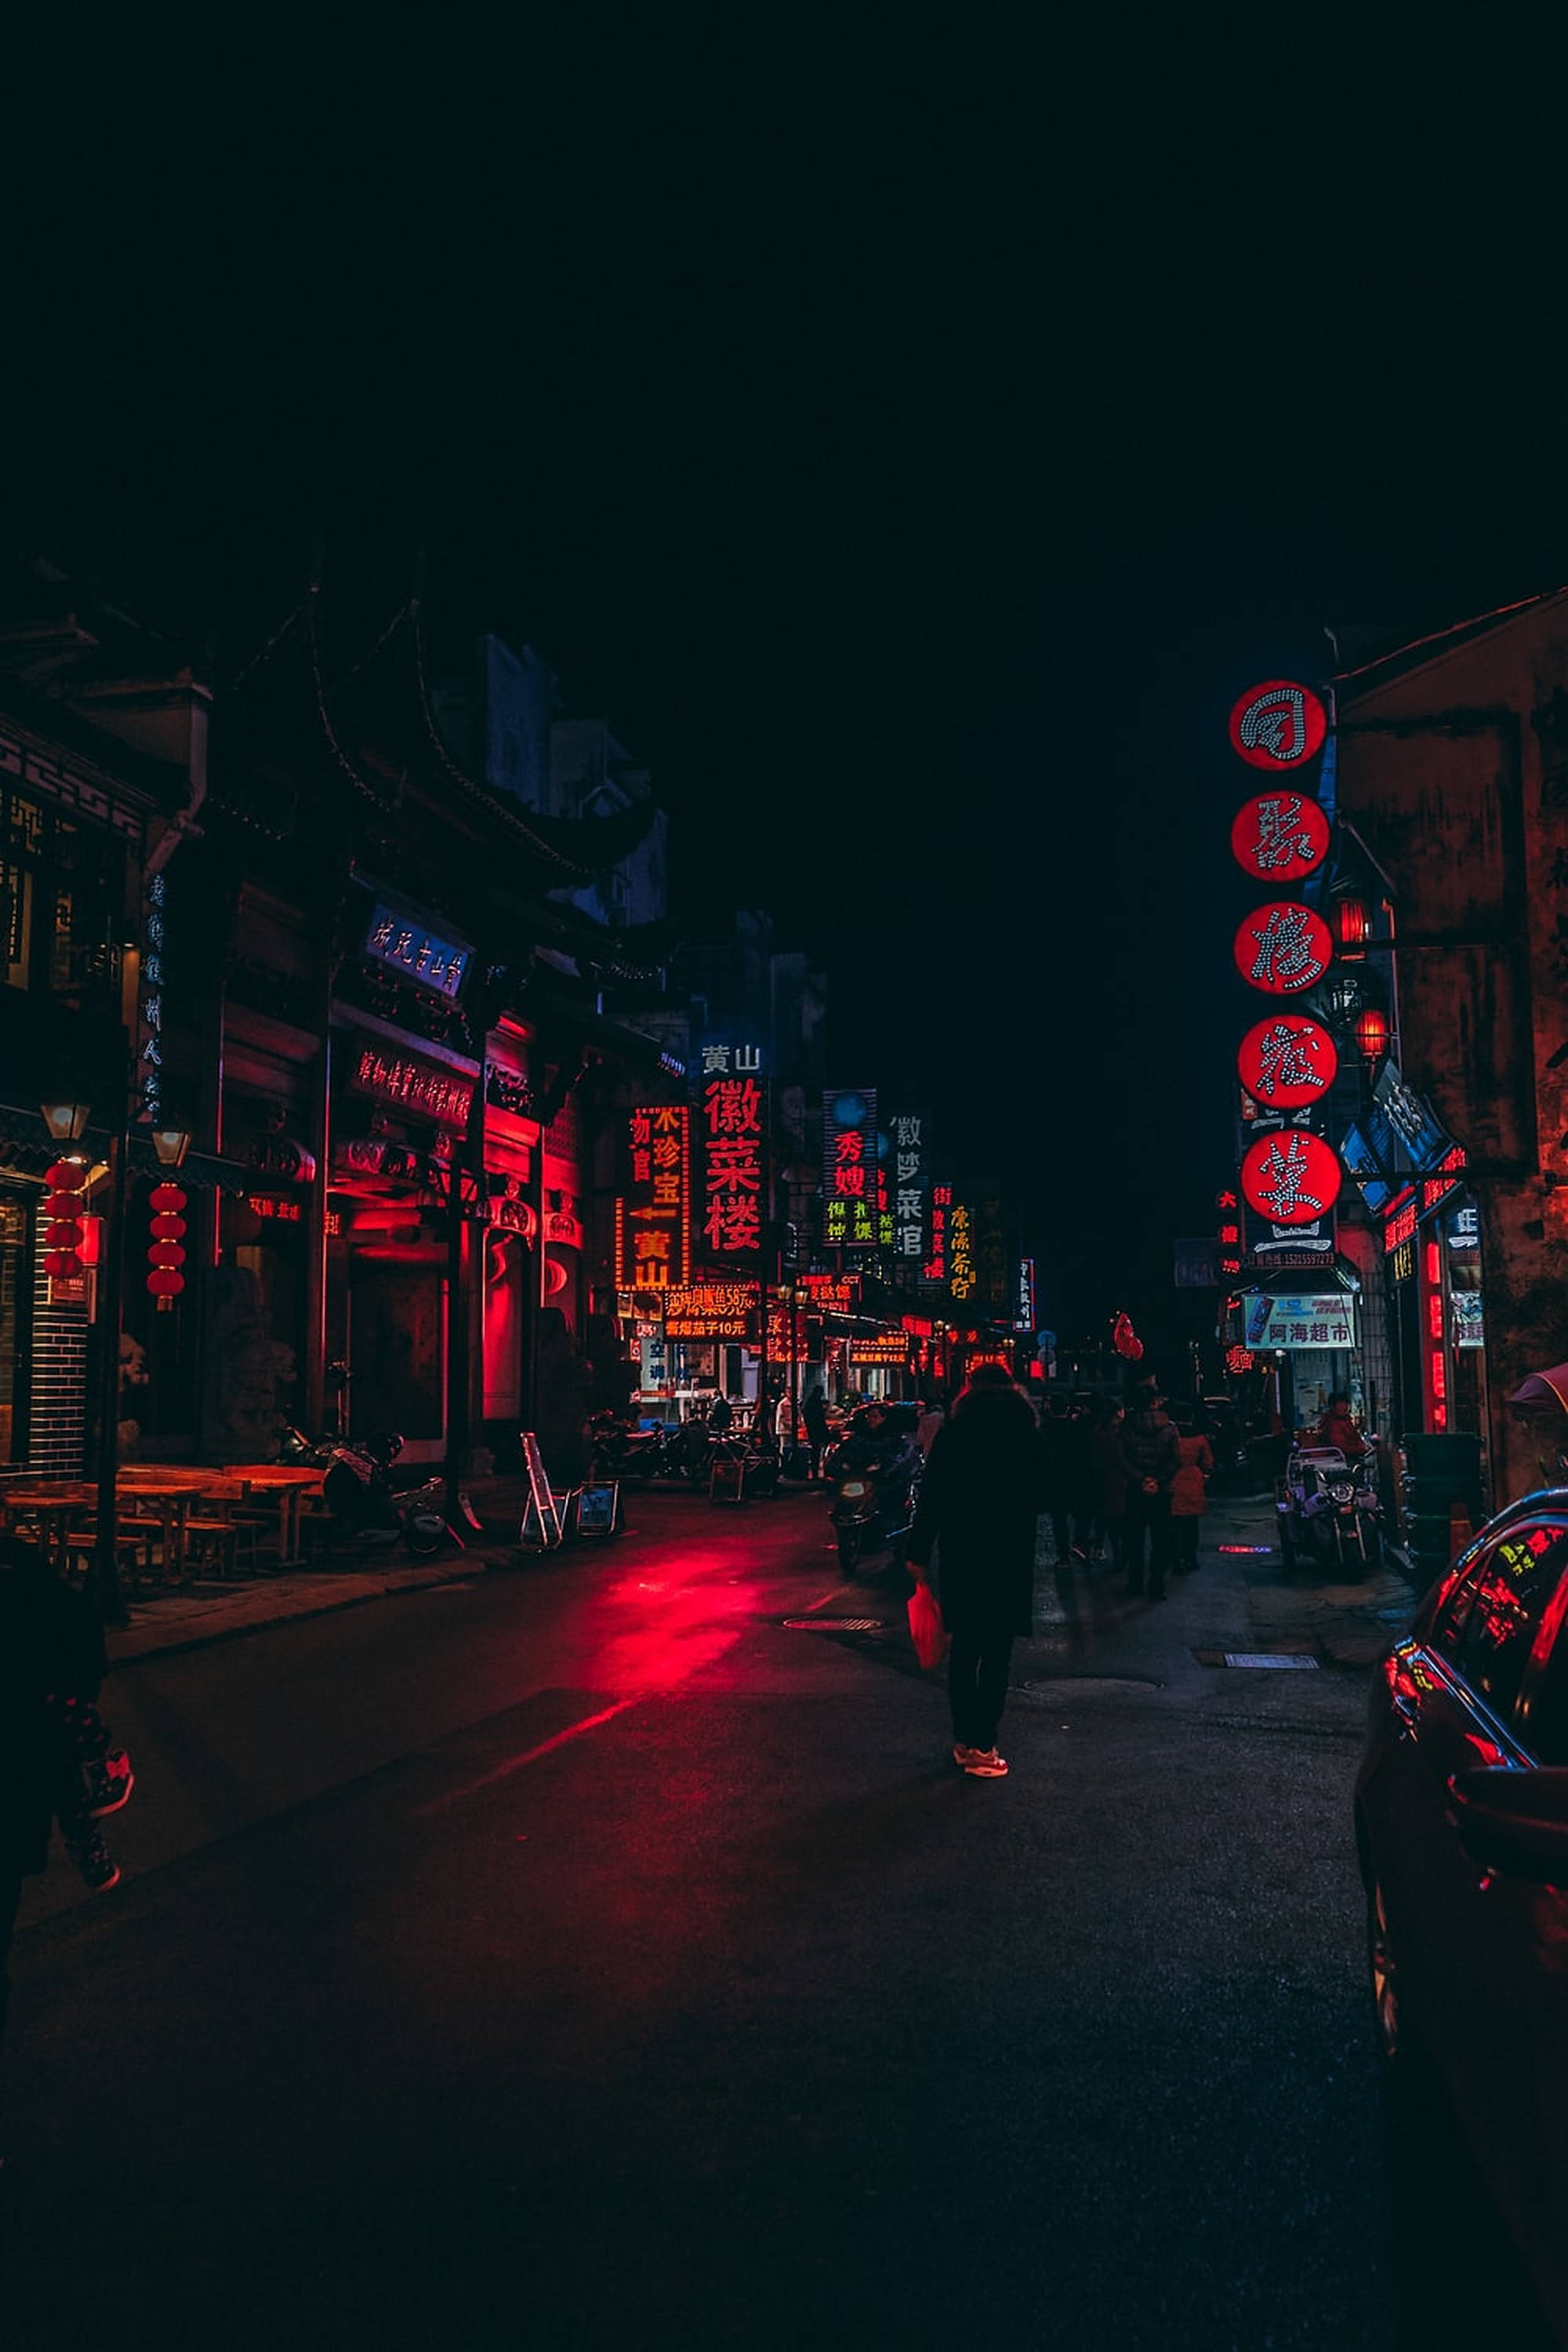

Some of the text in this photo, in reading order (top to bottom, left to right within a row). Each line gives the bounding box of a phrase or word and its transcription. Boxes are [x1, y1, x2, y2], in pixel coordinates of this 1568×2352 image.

[702, 1045, 760, 1073] 黄山
[704, 1079, 761, 1250] 徽菜楼
[634, 1231, 669, 1287] 黄山
[1269, 1323, 1349, 1343] 阿海超市
